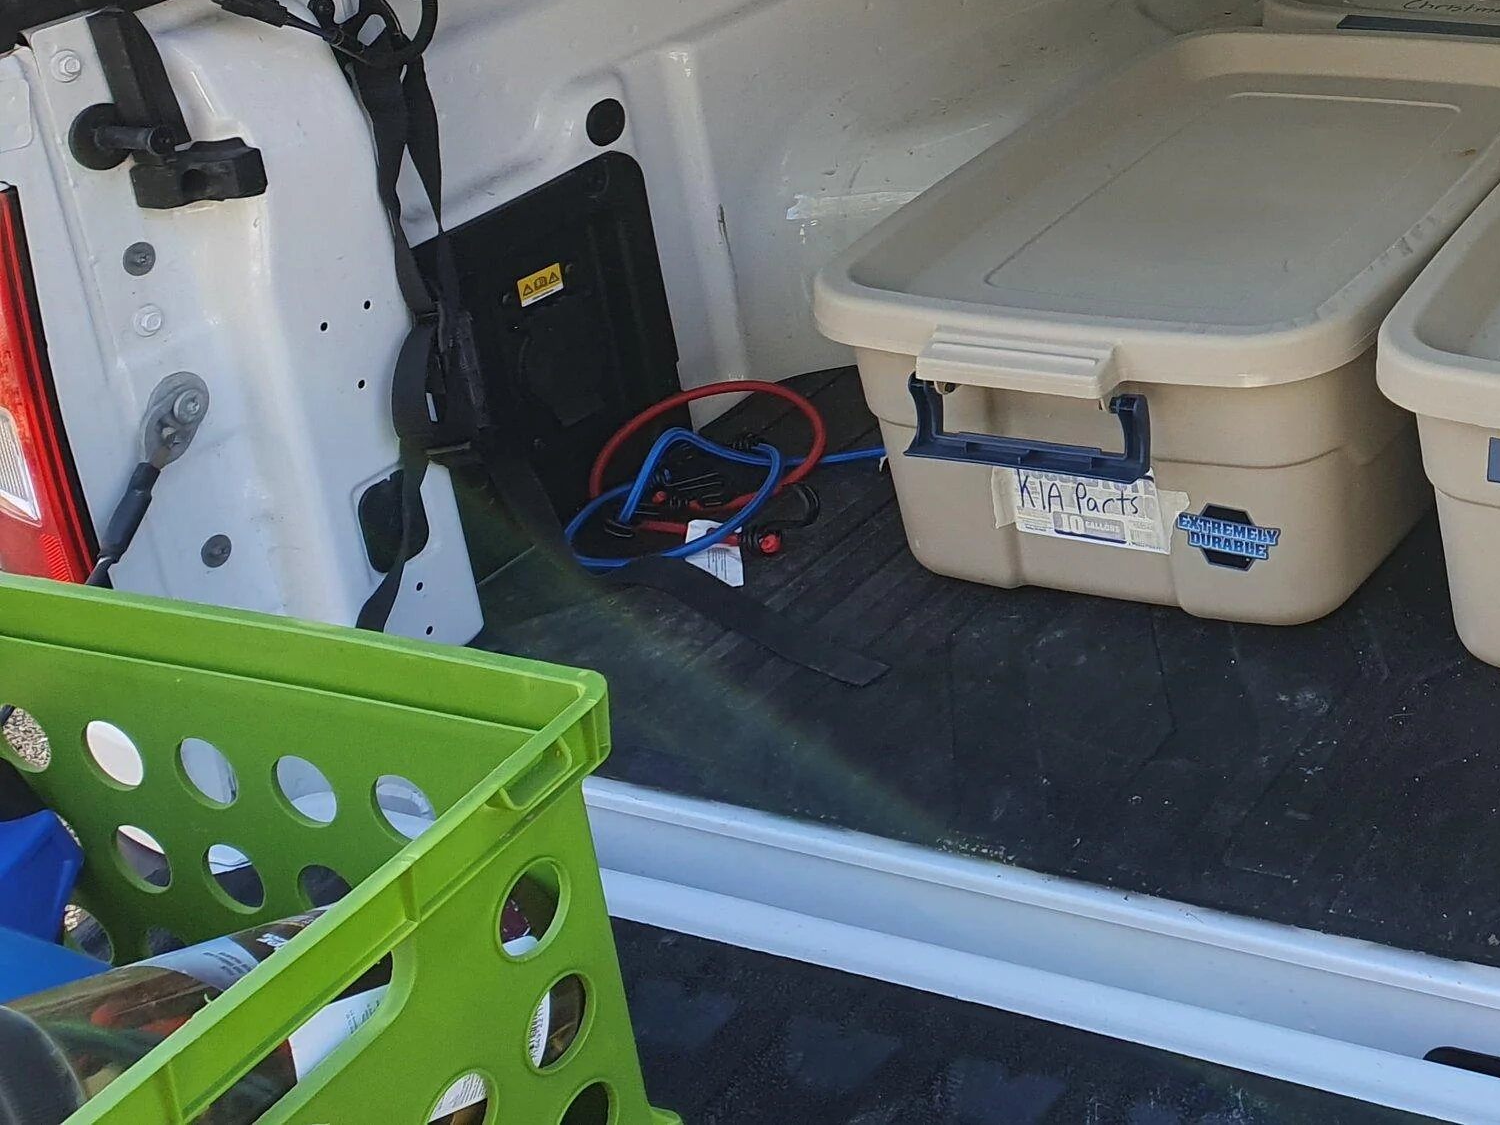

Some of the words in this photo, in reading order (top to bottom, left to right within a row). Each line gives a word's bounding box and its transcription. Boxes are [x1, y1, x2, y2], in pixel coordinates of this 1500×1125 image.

[1016, 468, 1064, 513] KIA
[1075, 481, 1139, 515] Parts
[1060, 513, 1085, 534] 10
[1084, 520, 1122, 535] GALLONS
[1178, 514, 1279, 545] EXTREMELY
[1189, 531, 1268, 559] DURABLE
